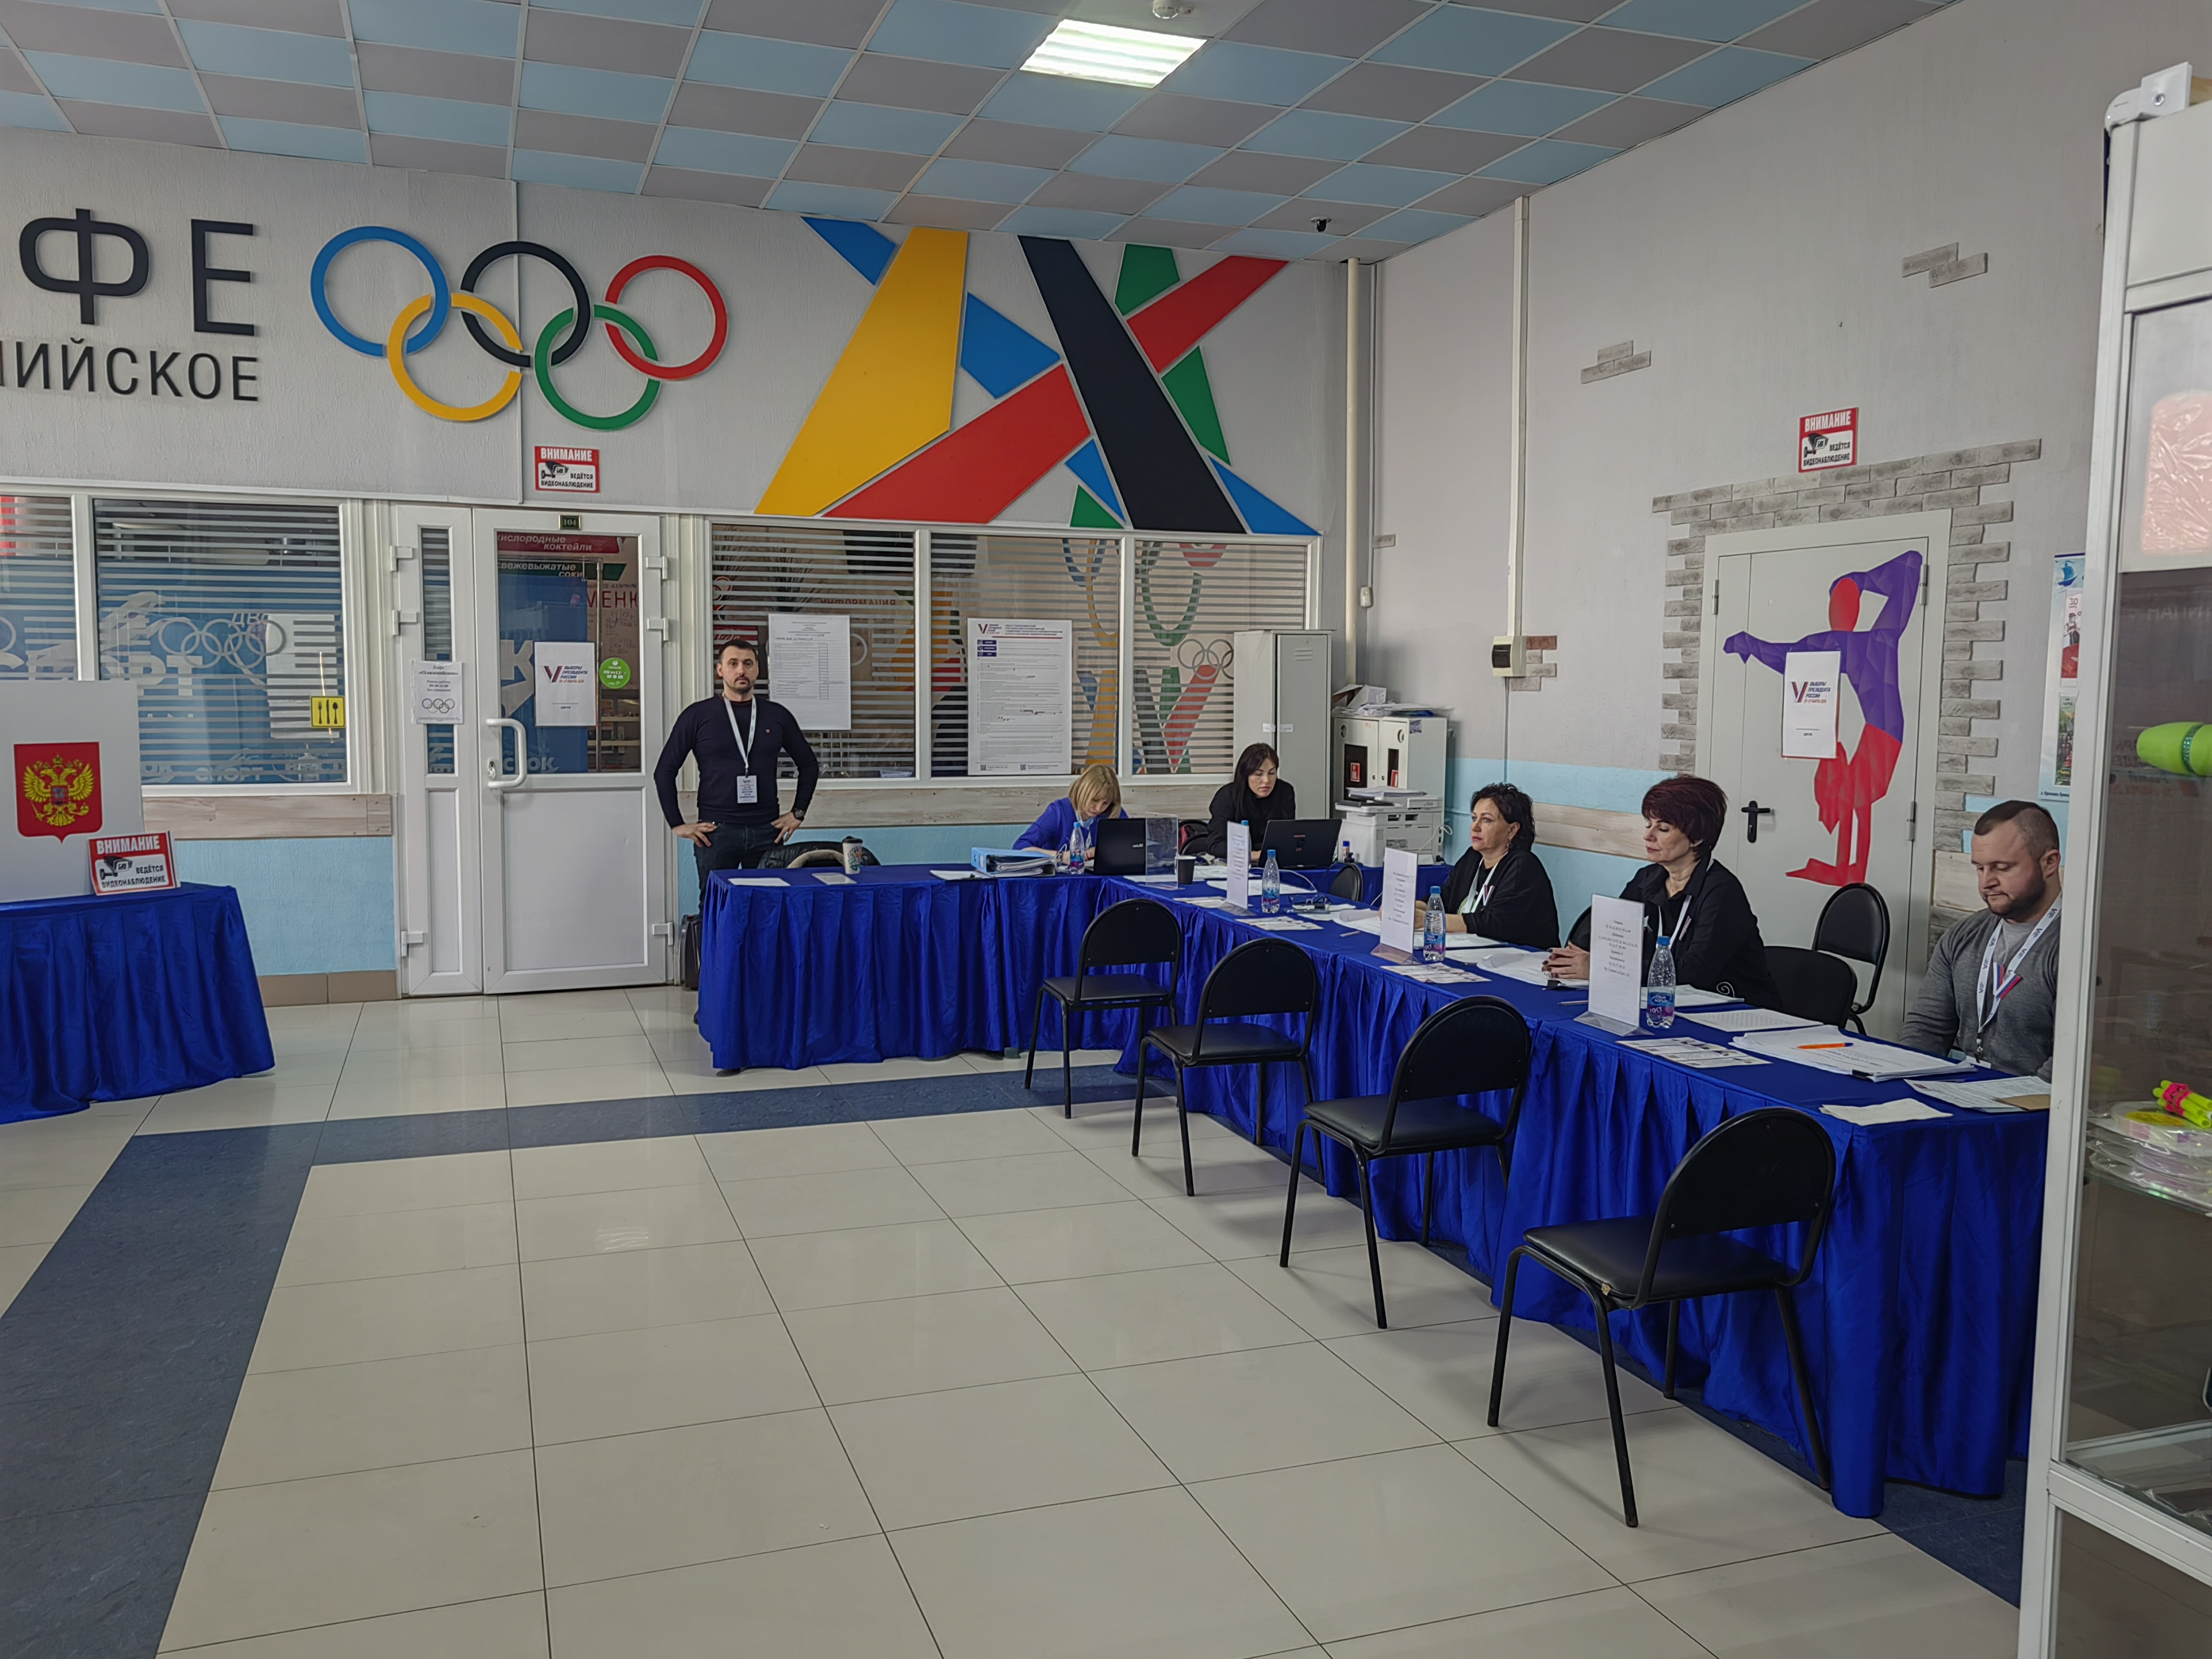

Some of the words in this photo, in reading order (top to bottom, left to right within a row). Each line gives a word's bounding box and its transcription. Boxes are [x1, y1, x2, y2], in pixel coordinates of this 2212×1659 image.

[1804, 410, 1851, 433] ВНИМАНИЕ
[1829, 441, 1850, 451] ВЕДЁТСЯ
[541, 447, 592, 462] ВНИМАНИЕ
[1803, 453, 1850, 467] ВИДЕОНАБЛЮДЕНИЕ
[541, 480, 594, 488] ВИДЕОНАБЛЮДЕНИЕ
[543, 542, 592, 551] коктейли
[96, 835, 160, 855] ВНИМАНИЕ
[136, 865, 164, 874] ВЕДЁТСЯ
[102, 875, 166, 889] ВИДЕОНАБЛЮДЕНИЕ
